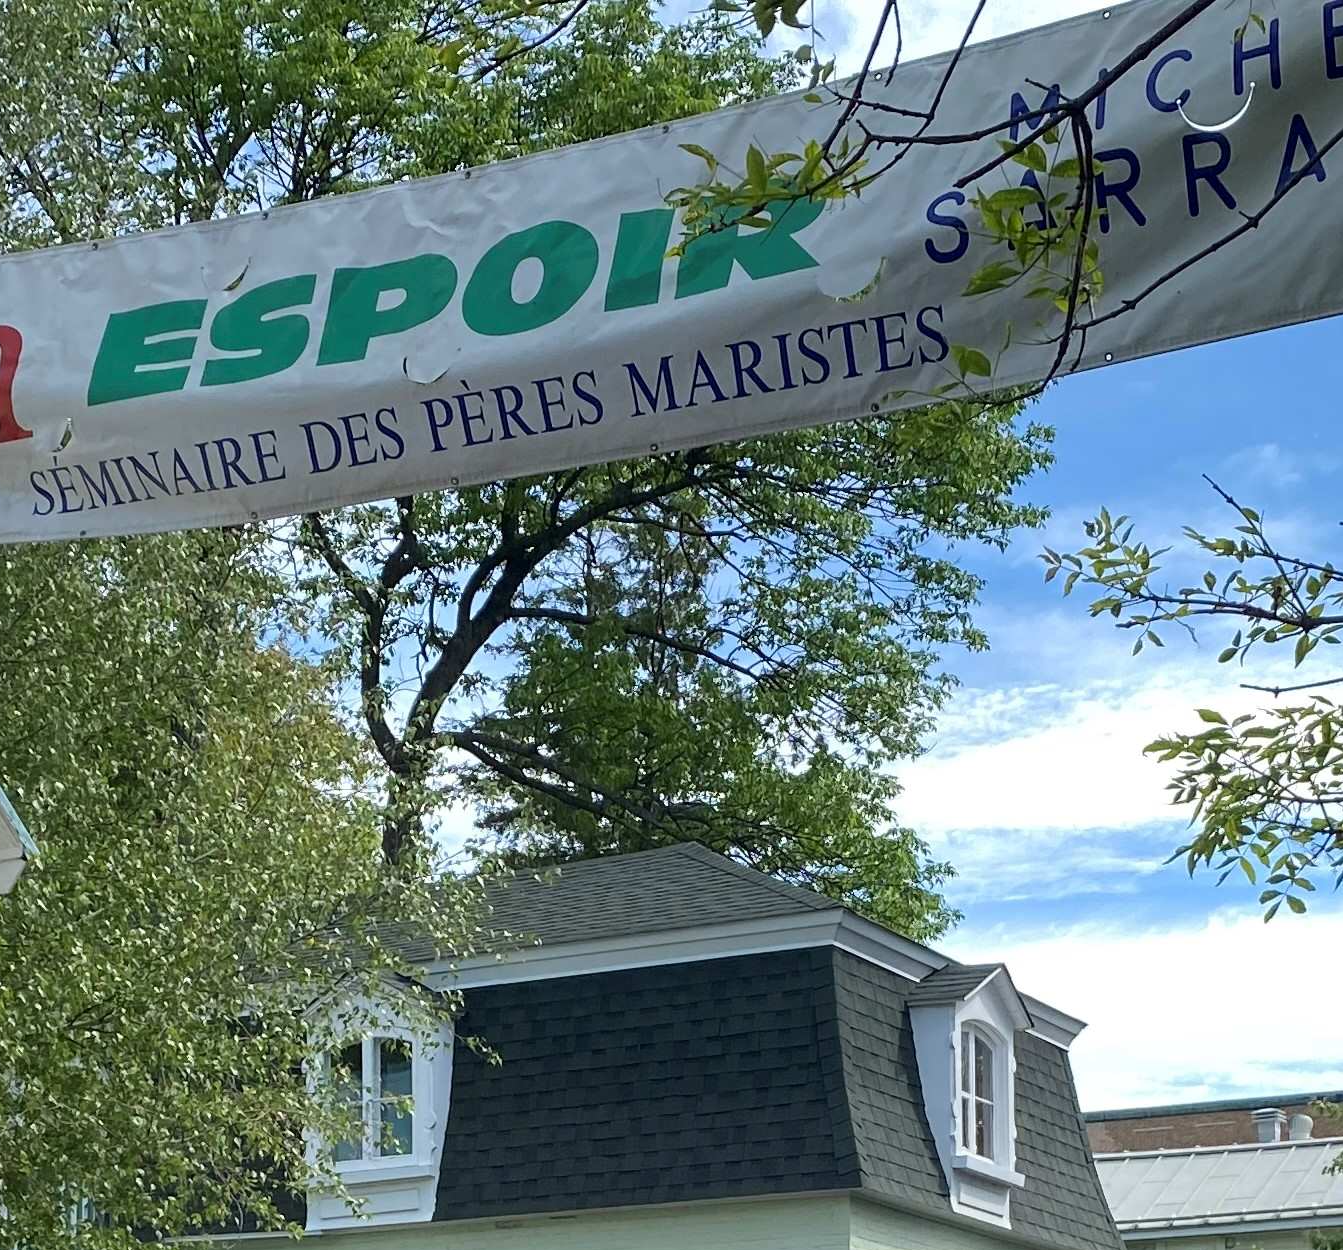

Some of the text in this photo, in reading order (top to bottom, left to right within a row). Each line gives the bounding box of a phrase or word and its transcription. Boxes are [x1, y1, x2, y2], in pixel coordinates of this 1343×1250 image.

[88, 176, 824, 406] ESPOIR
[30, 304, 951, 516] SÉMINAIRE DES PÈRES MARISTES
